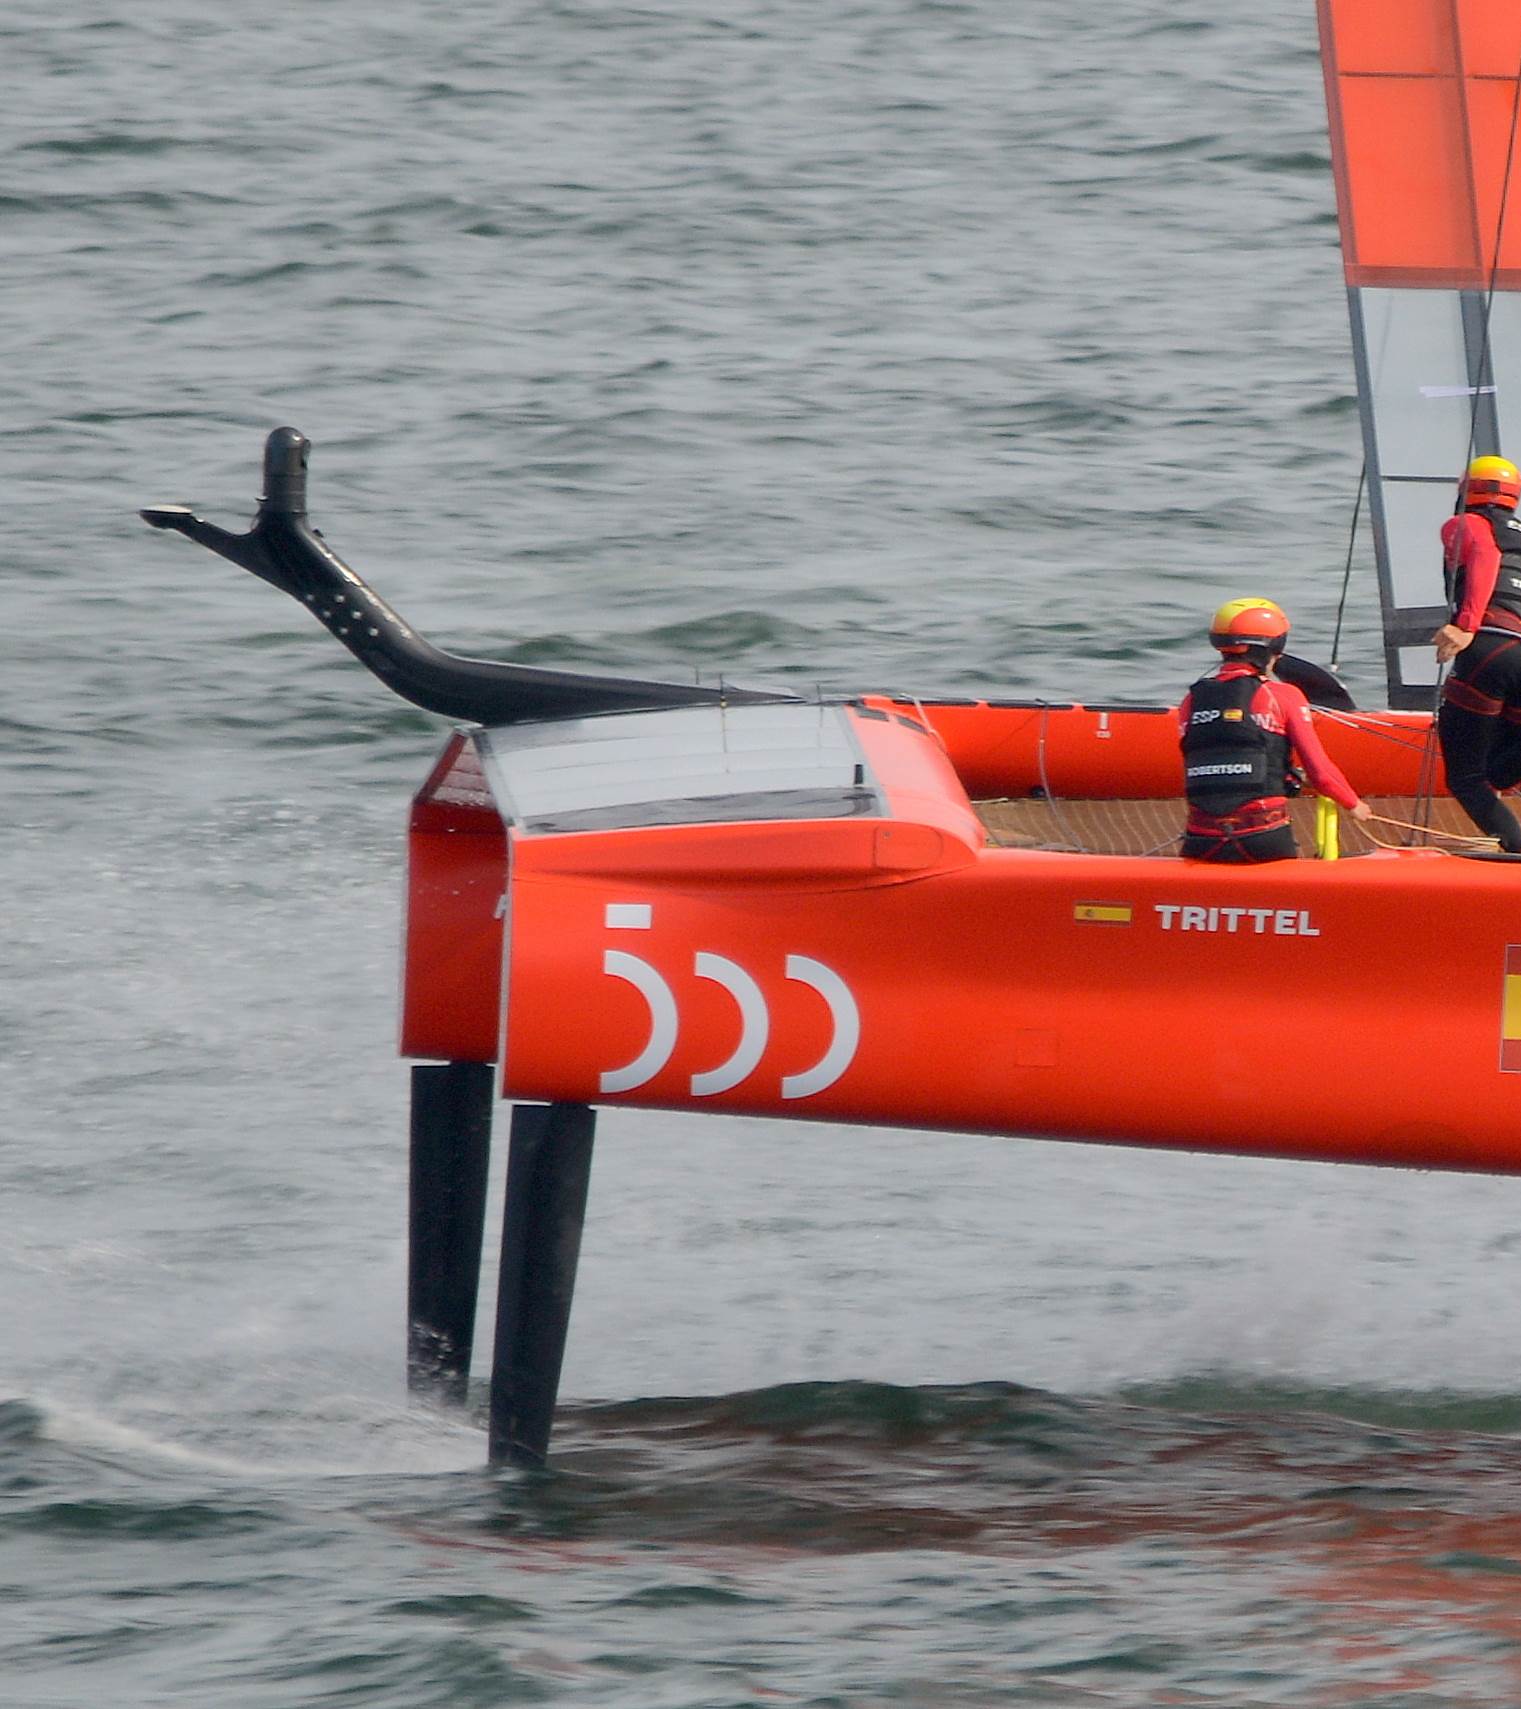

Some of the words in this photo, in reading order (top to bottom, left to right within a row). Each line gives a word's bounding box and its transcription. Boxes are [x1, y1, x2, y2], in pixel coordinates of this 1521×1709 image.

[1191, 709, 1220, 725] ESP
[1187, 763, 1252, 777] ROBERTSON
[1154, 905, 1320, 936] TRITTEL
